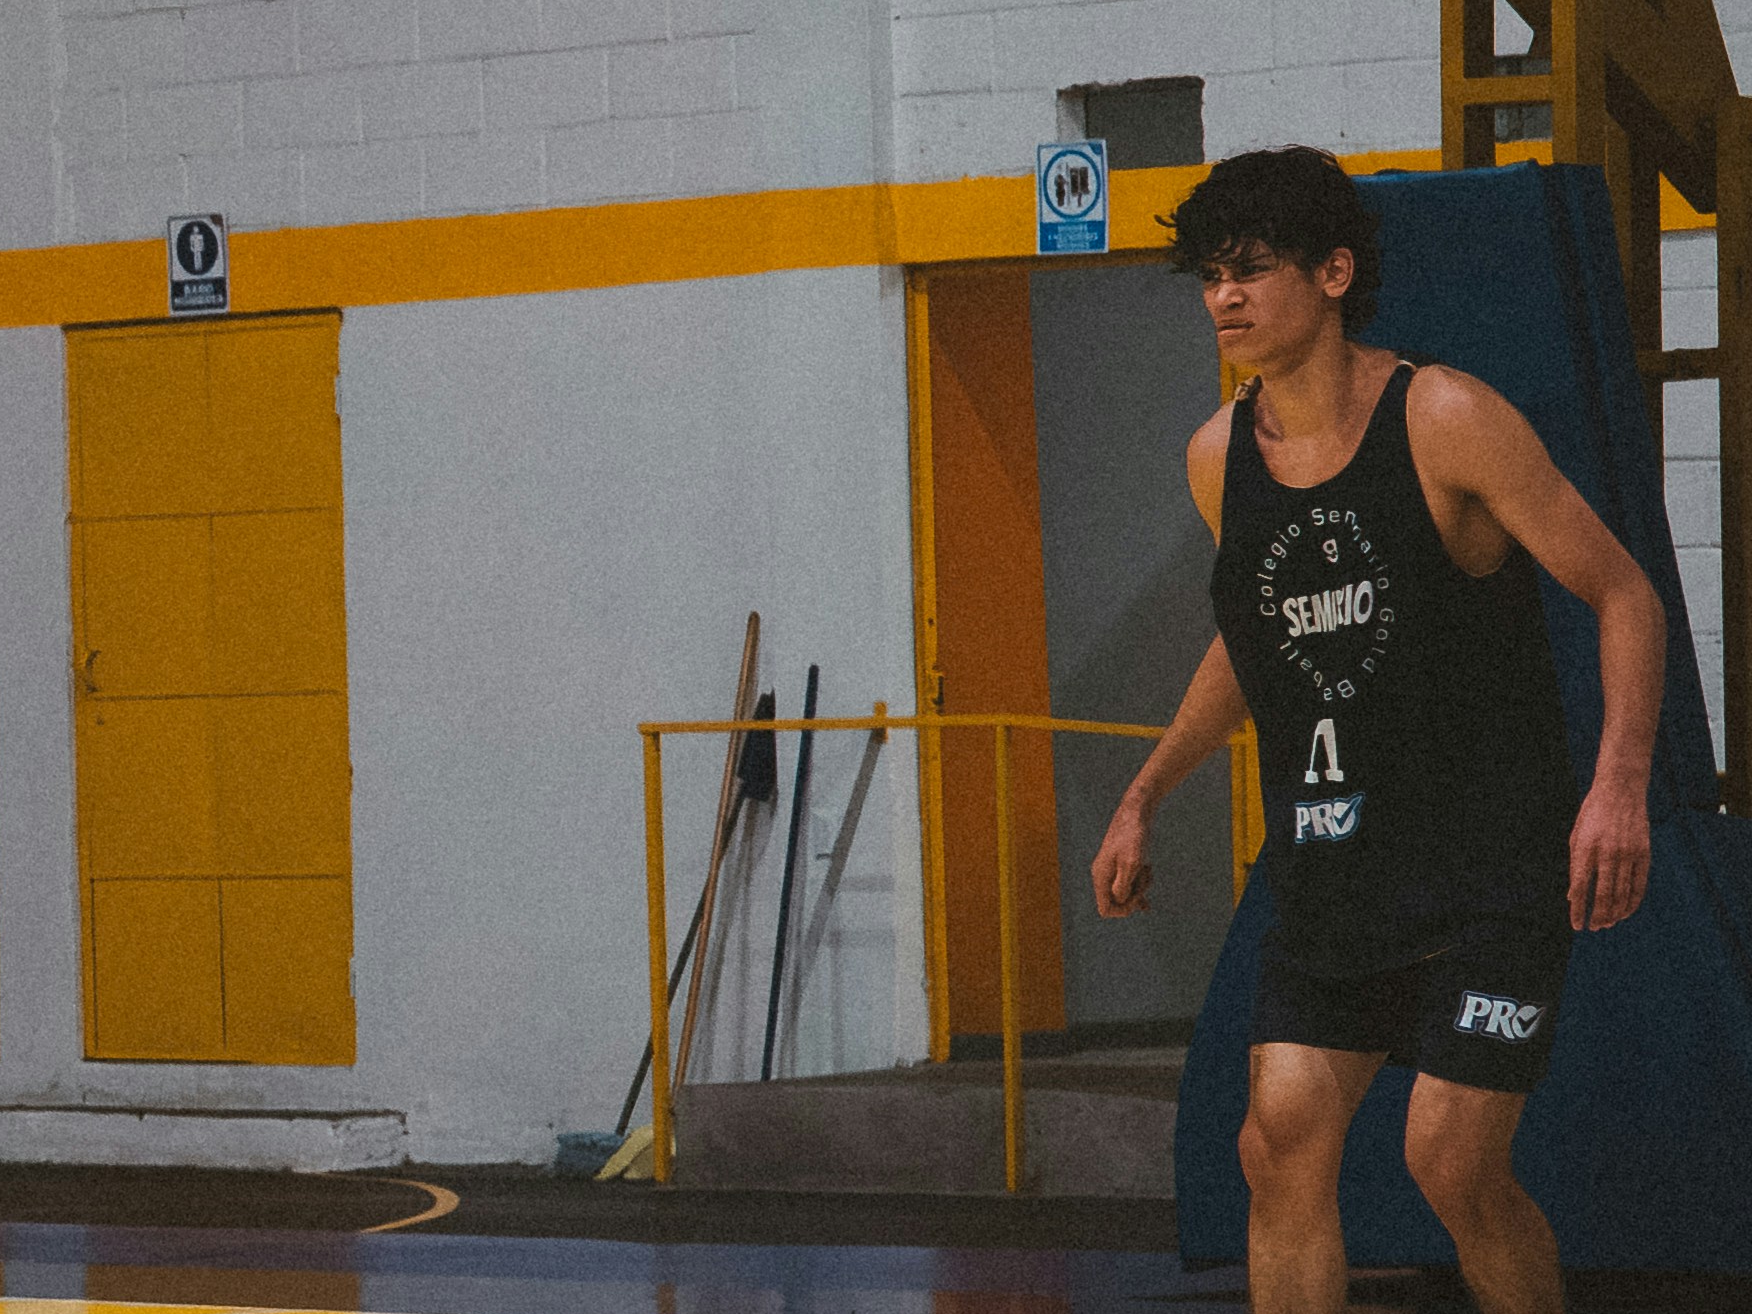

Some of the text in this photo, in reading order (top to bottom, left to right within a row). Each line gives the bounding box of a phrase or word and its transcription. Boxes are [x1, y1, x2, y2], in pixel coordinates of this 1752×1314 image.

[1260, 524, 1301, 616] Colegio
[1361, 608, 1395, 674] Gold
[1296, 798, 1361, 839] PRO
[1459, 994, 1544, 1040] PRO
